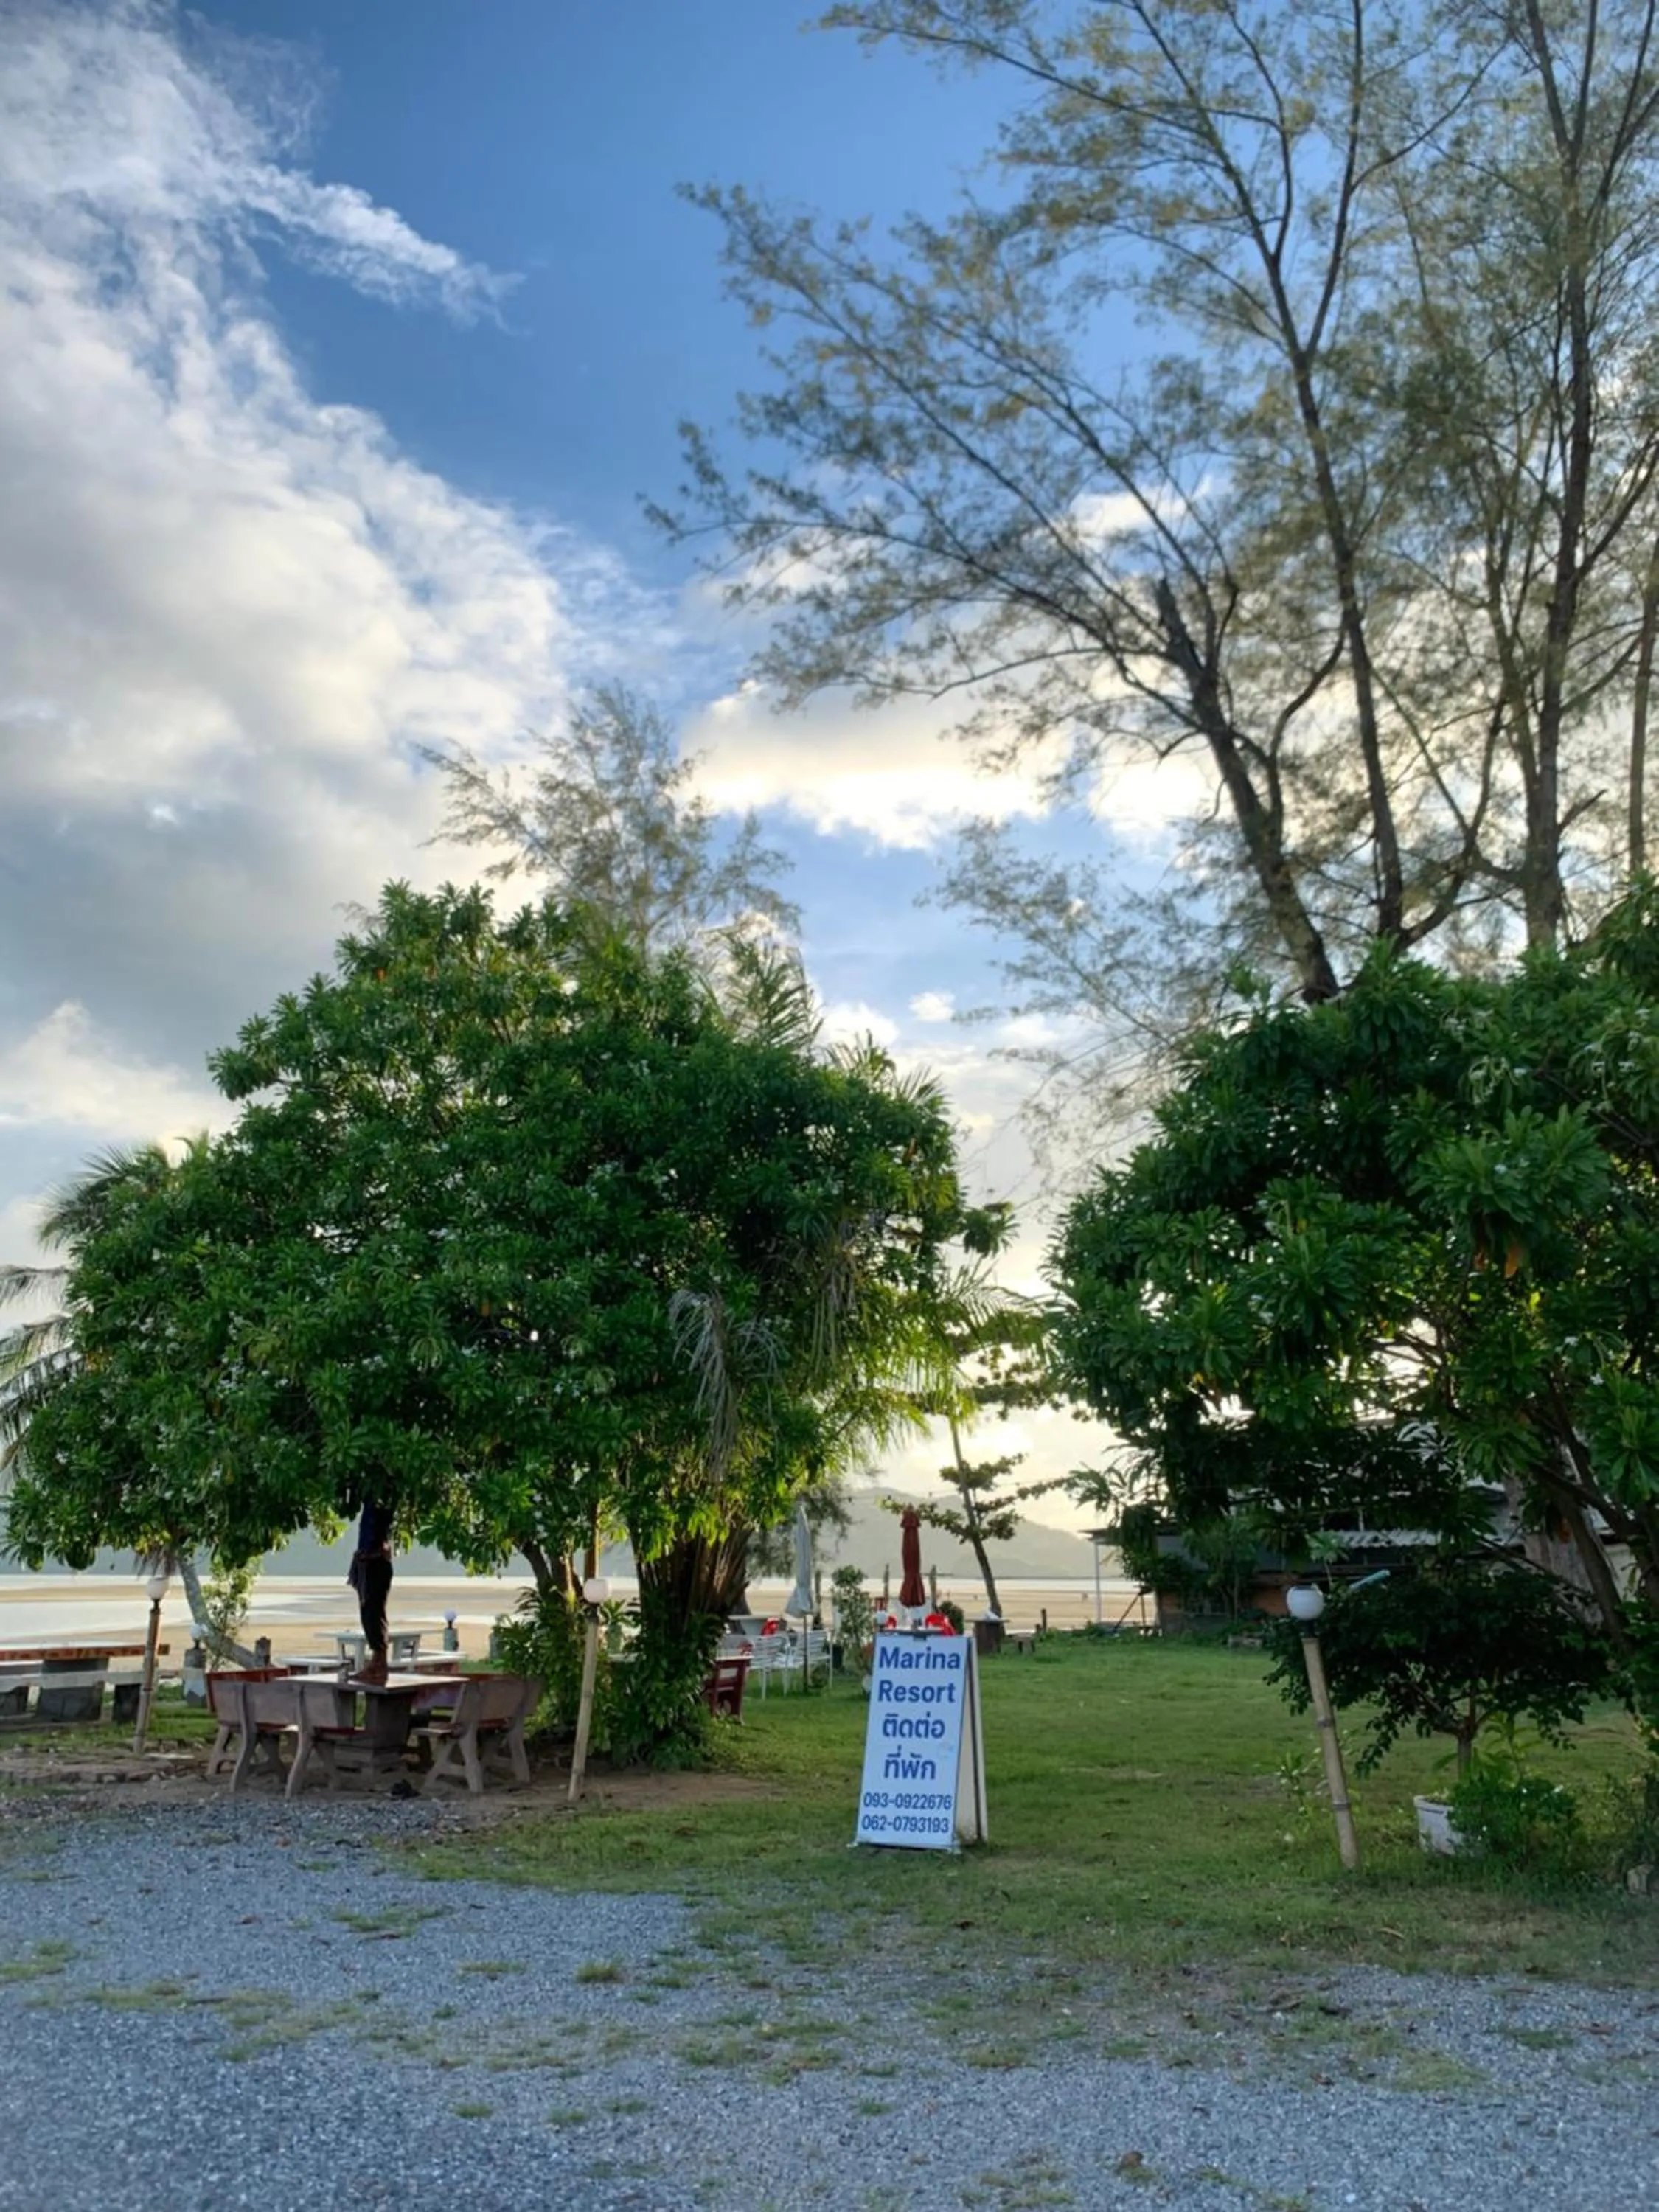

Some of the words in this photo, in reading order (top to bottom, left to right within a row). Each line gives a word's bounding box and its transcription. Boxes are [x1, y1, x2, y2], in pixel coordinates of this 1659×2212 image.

[879, 1646, 961, 1669] Marina
[878, 1680, 956, 1703] Resort
[883, 1711, 945, 1739] ติดต่อ
[884, 1745, 936, 1780] ที่พัก
[863, 1792, 952, 1810] 093-0922676
[862, 1815, 949, 1833] 062-0793193
